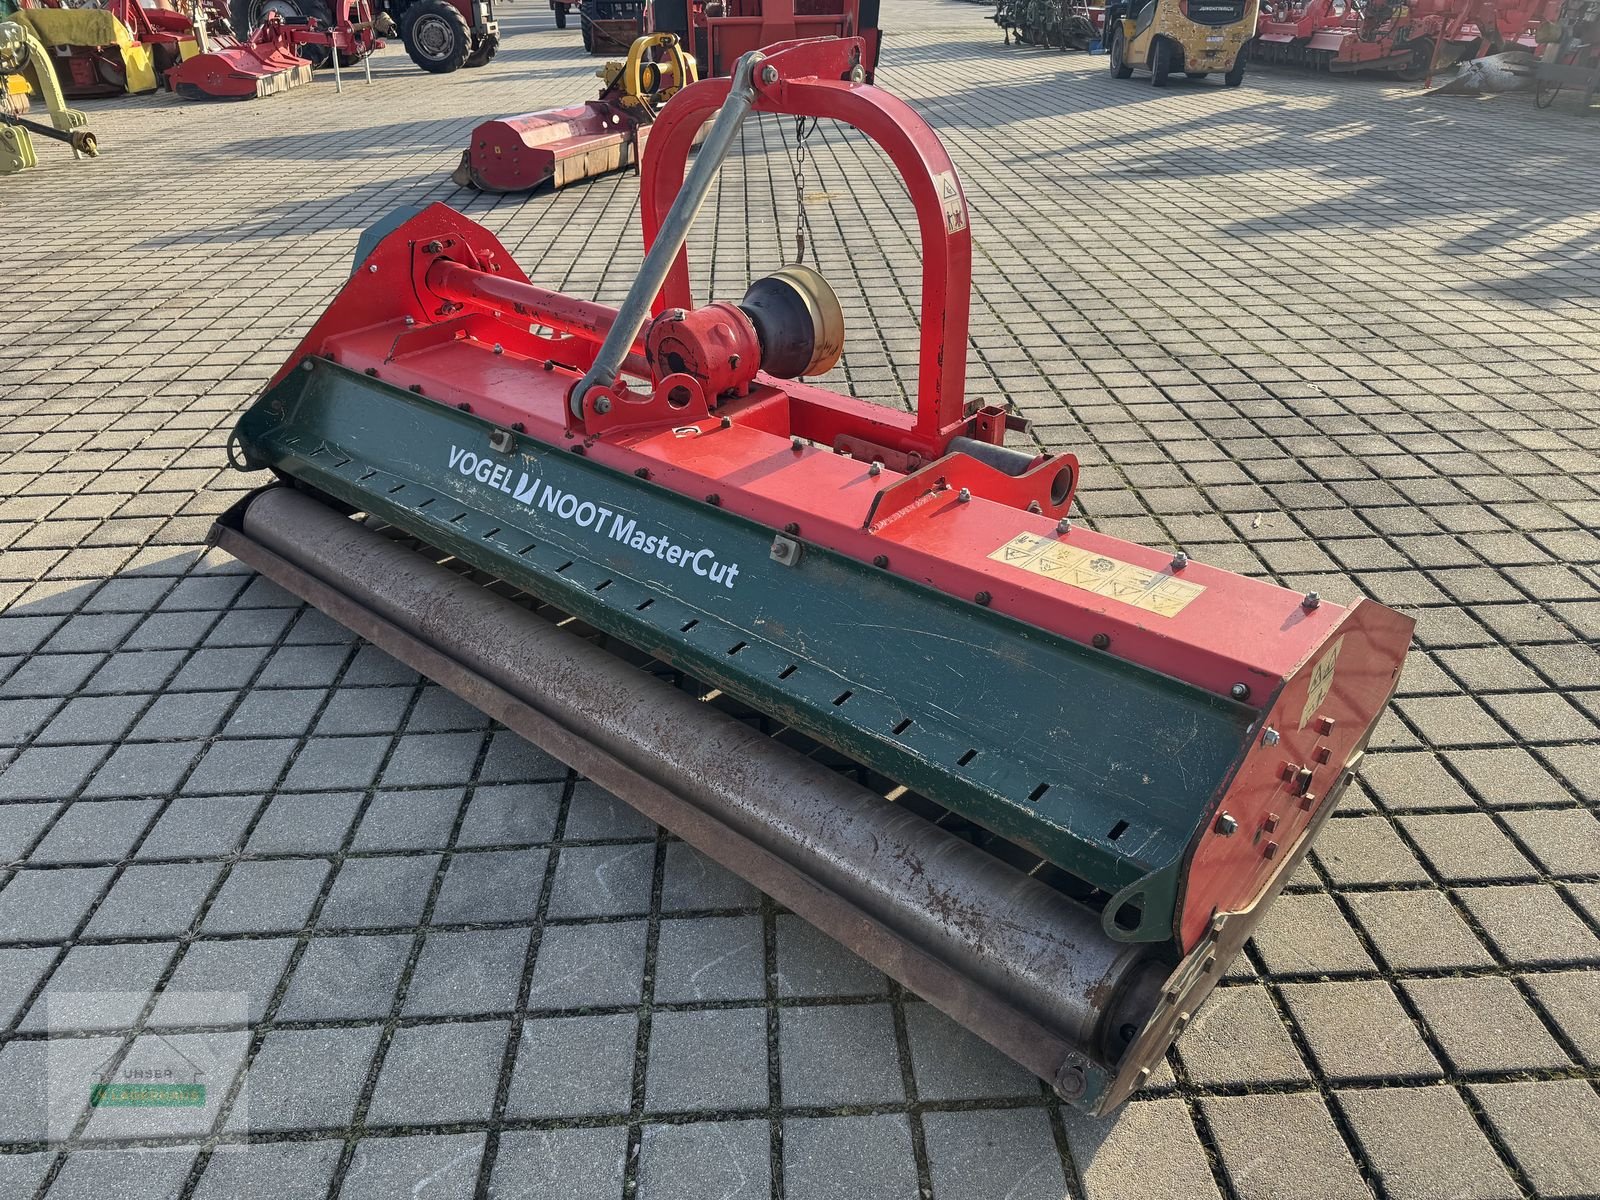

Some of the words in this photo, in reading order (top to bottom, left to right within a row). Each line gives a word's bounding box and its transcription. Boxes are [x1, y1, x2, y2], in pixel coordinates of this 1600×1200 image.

[447, 445, 513, 494] VOGEL
[538, 484, 613, 533] NOOT
[608, 515, 740, 589] MasterCut
